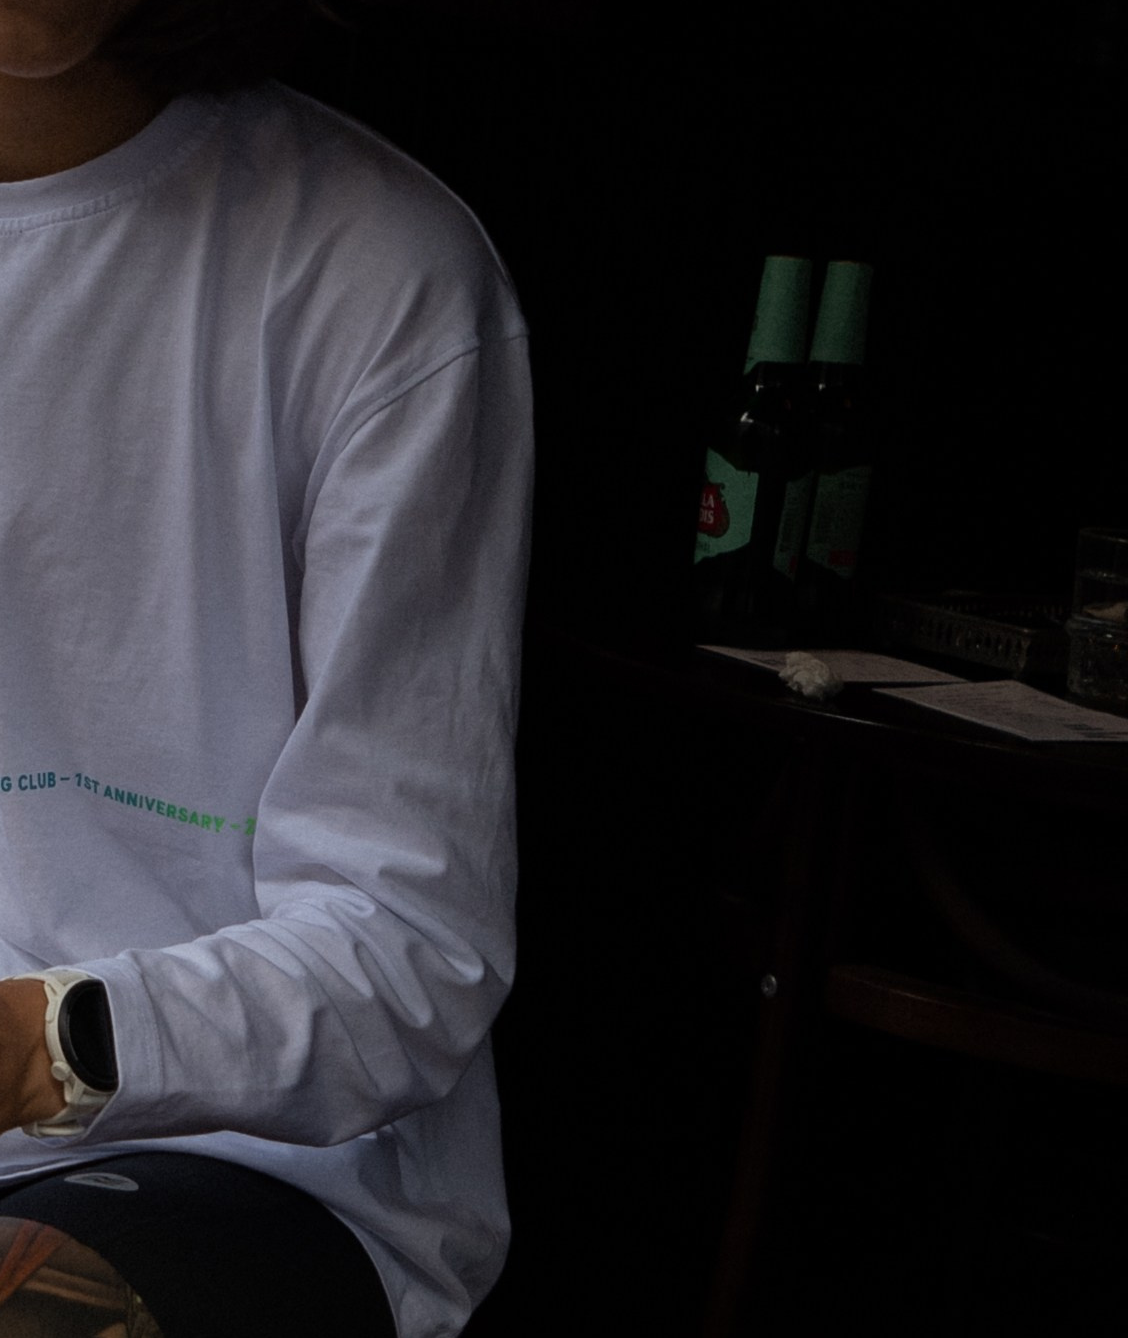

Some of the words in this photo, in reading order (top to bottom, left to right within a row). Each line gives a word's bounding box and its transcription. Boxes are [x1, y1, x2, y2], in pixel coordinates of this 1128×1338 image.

[18, 771, 57, 791] CLUB
[75, 773, 100, 794] 1ST
[103, 785, 226, 834] ANNIVERSARY
